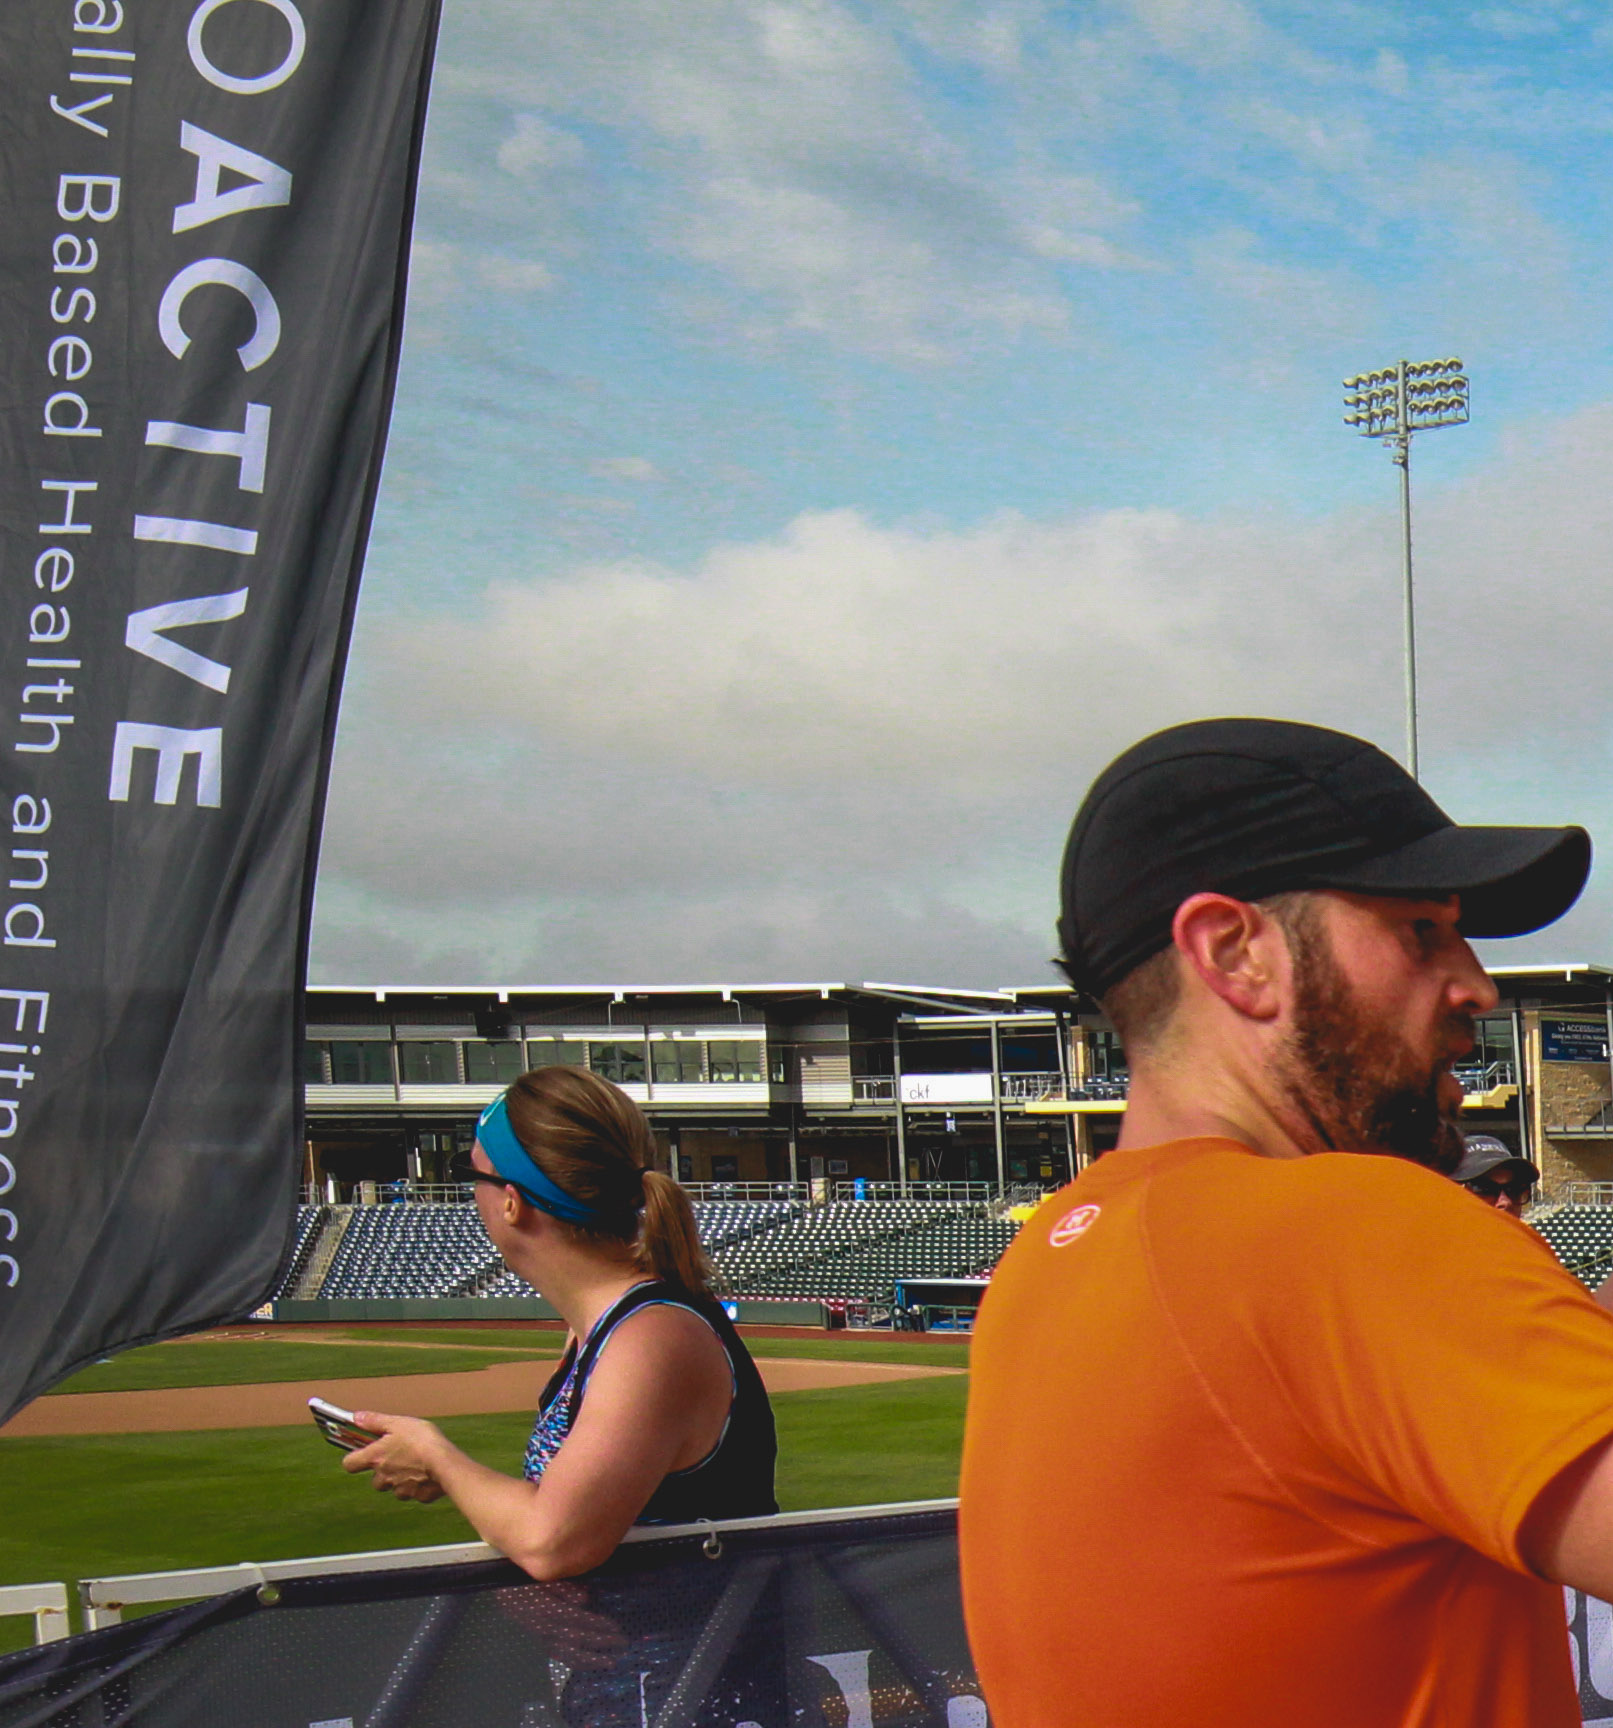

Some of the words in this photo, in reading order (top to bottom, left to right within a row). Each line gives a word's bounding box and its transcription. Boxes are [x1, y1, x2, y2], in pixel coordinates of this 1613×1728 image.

[43, 174, 121, 437] Based
[110, 0, 306, 808] OACTIVE
[16, 480, 98, 753] Health
[4, 795, 57, 948] and
